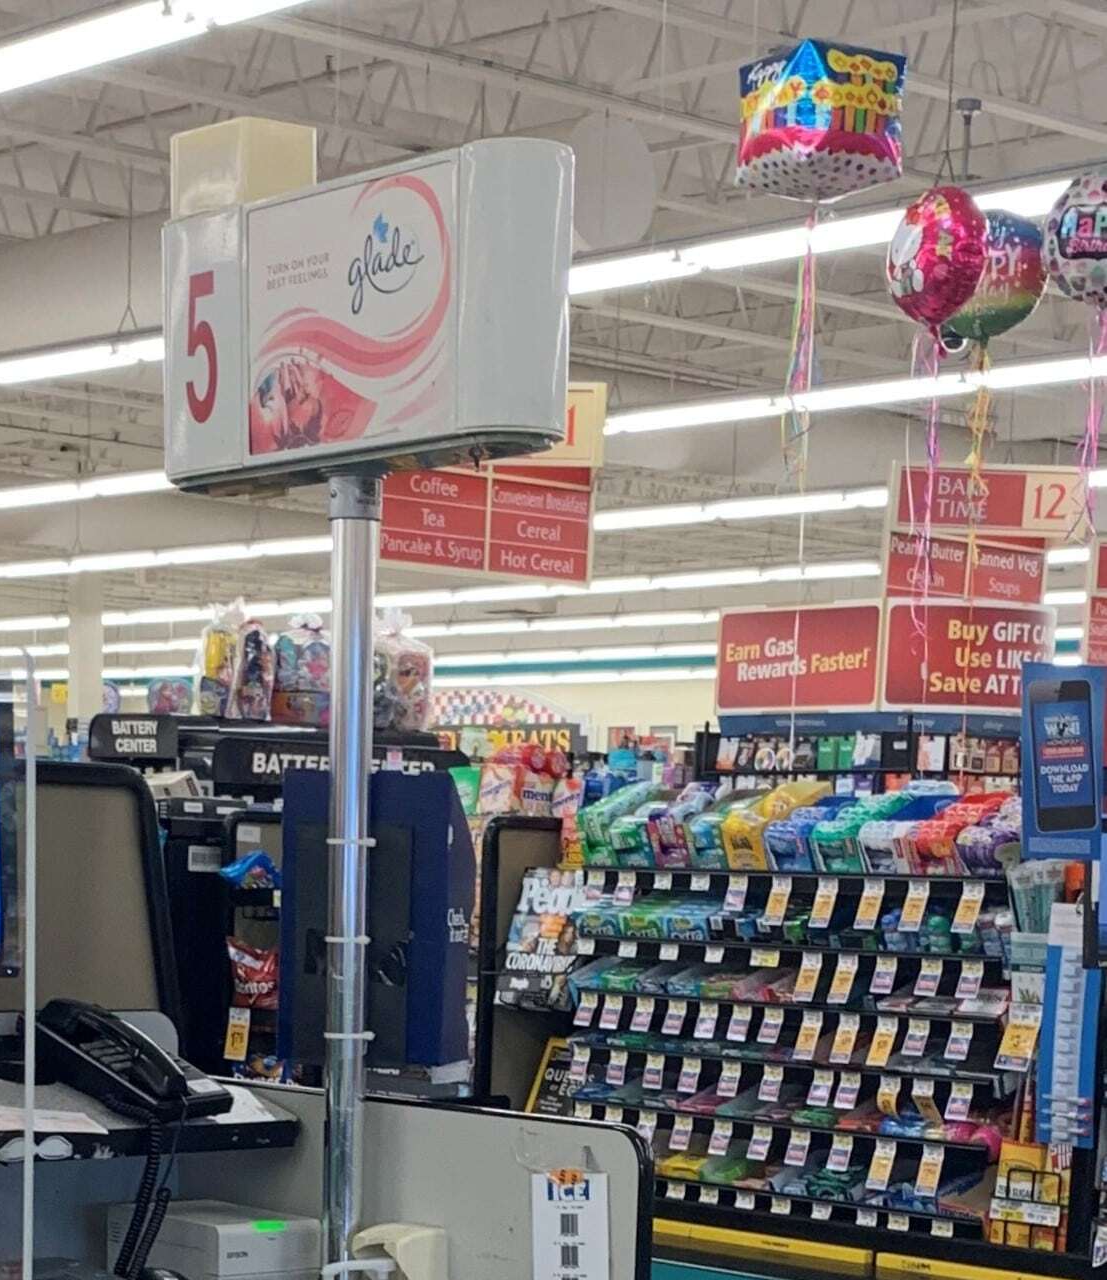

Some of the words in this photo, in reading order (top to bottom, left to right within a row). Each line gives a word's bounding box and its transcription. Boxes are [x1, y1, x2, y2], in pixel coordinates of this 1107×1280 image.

[348, 226, 425, 315] glade
[185, 270, 218, 423] 5
[410, 474, 459, 498] Coffee
[1033, 484, 1067, 520] 12
[420, 508, 446, 528] Tea
[516, 520, 561, 541] Cereal
[380, 533, 432, 556] Pancake
[434, 540, 445, 557] &
[448, 542, 483, 565] Syrup
[500, 550, 526, 569] Hot
[530, 553, 574, 574] Cereal
[947, 619, 989, 646] Buy
[993, 621, 1031, 643] GIFT
[726, 641, 760, 663] Earn
[954, 647, 993, 668] Use
[737, 657, 807, 682] Rewards
[810, 648, 869, 673] Faster!
[929, 672, 981, 694] Save
[112, 720, 158, 737] BATTERY
[114, 739, 158, 753] CENTER
[252, 752, 331, 774] BATTER
